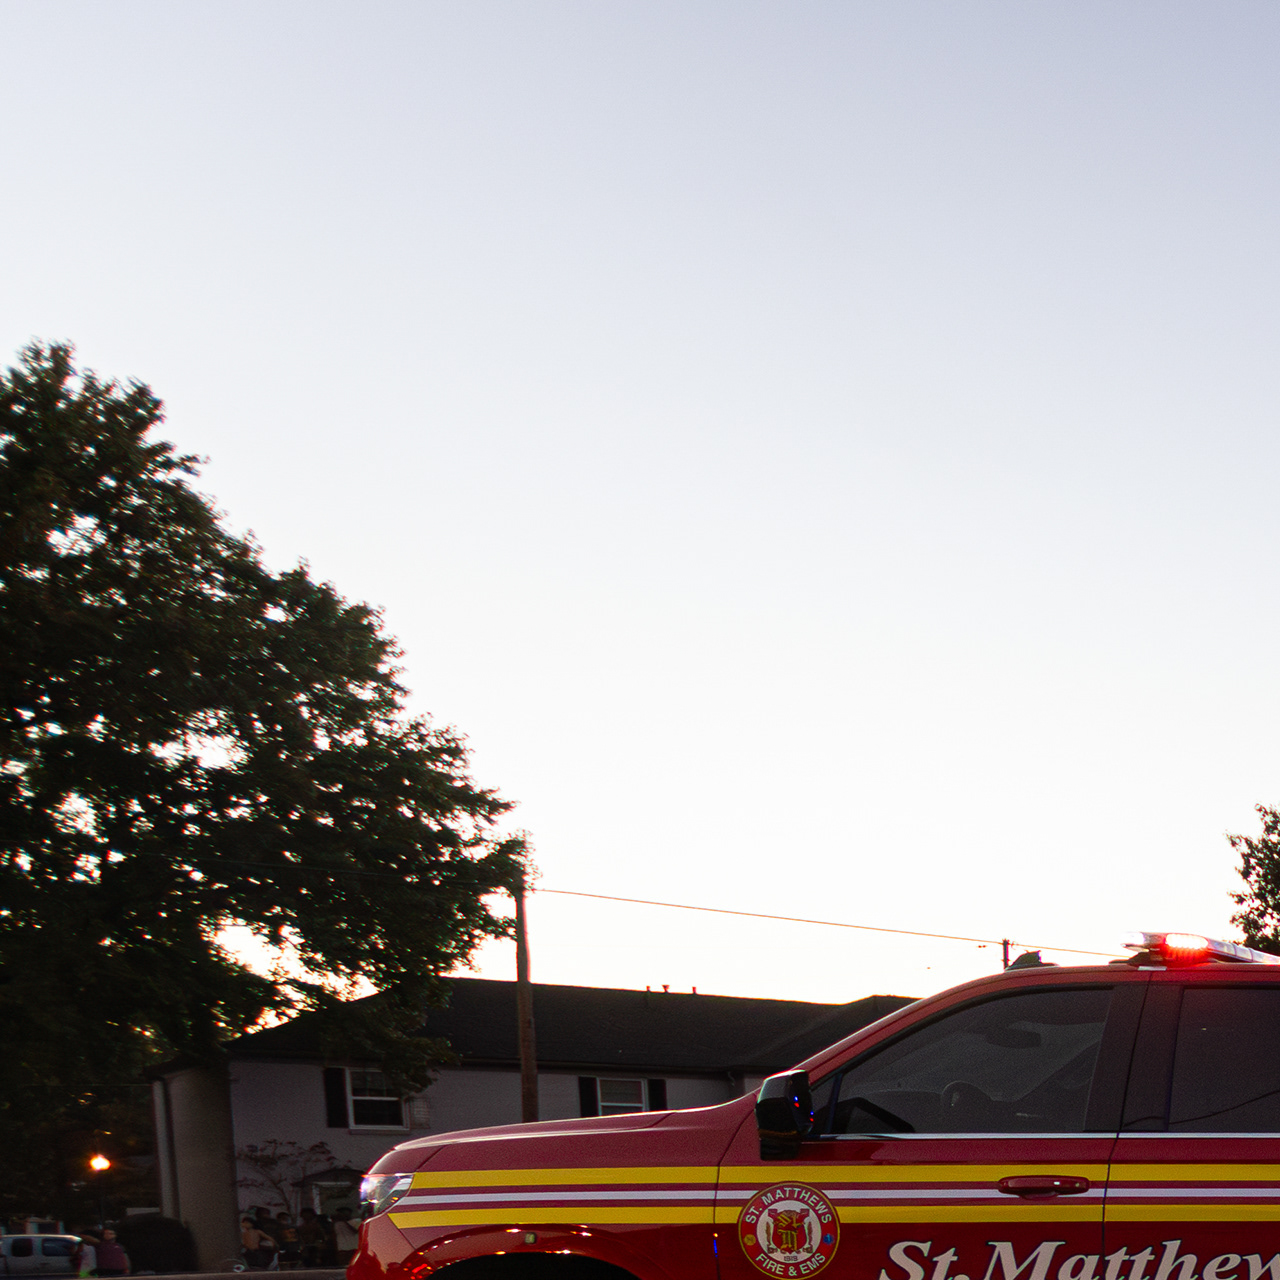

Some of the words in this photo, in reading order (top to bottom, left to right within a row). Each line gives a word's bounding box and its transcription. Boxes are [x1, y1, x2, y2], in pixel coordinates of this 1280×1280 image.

[745, 1206, 763, 1224] ST.
[761, 1187, 832, 1224] MATTHEWS
[755, 1253, 785, 1275] FIRE
[788, 1266, 797, 1276] &
[799, 1252, 826, 1274] EMS
